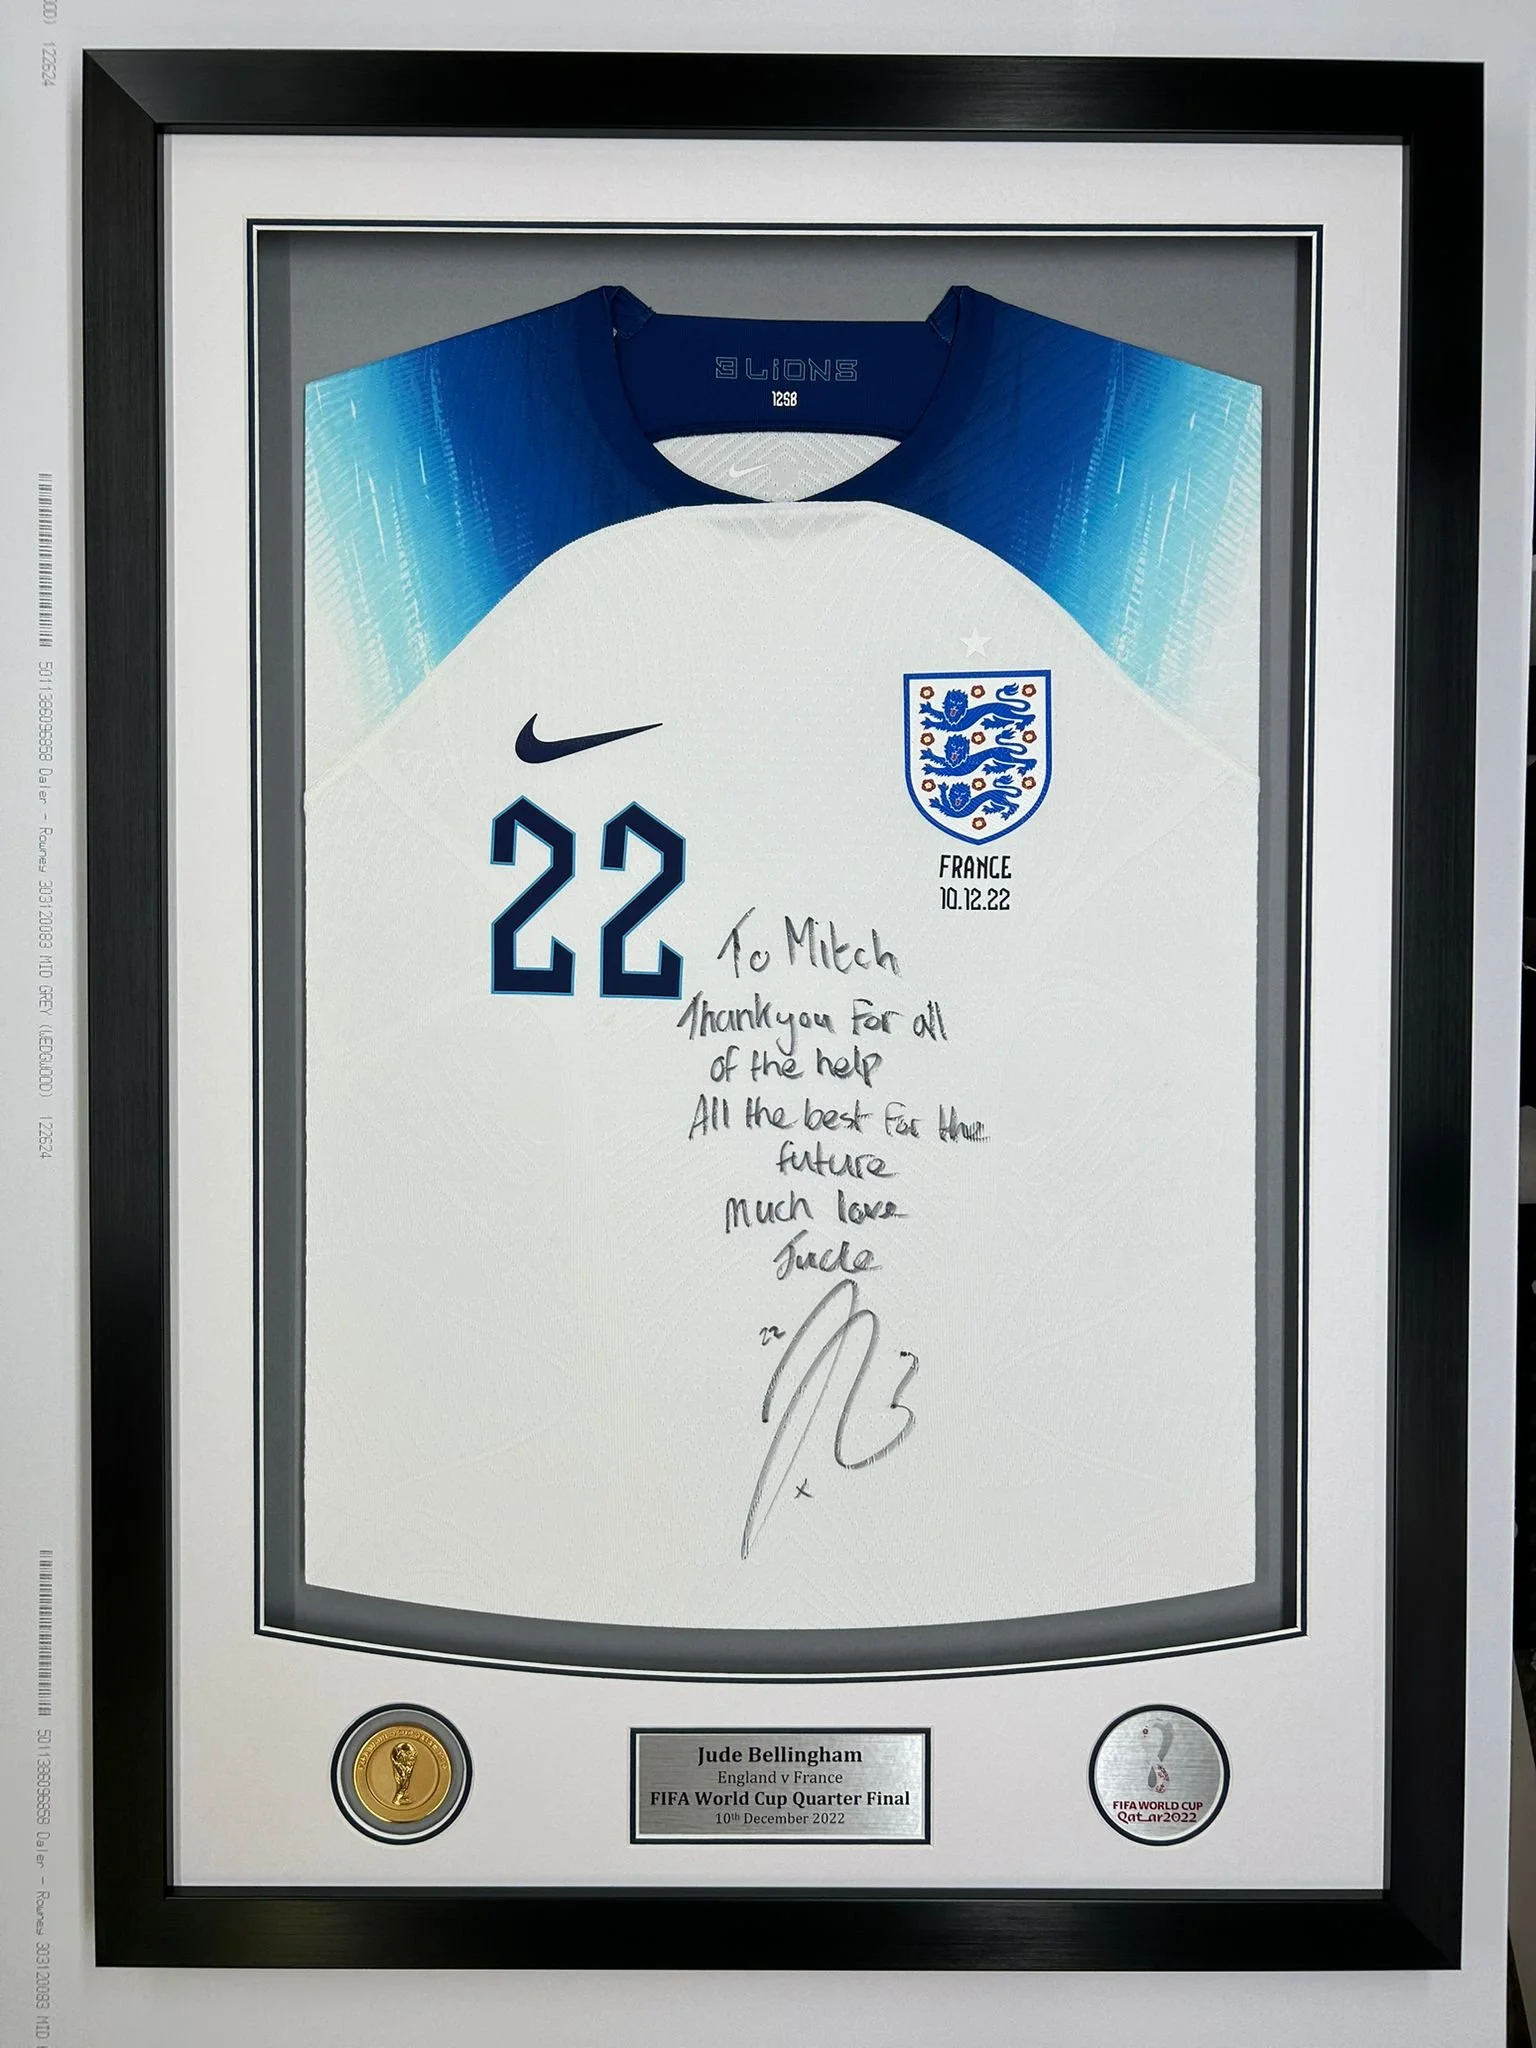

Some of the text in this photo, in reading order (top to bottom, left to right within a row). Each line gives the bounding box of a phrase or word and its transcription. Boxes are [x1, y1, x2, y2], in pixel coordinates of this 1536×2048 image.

[41, 40, 56, 88] 122624
[771, 390, 798, 407] 1258
[38, 767, 53, 805] Daler
[37, 826, 53, 873] Rowney
[938, 854, 1012, 880] FRANCE
[37, 879, 53, 949] 303120083
[489, 794, 687, 1001] 22
[939, 886, 1011, 911] 10.12.22
[716, 905, 902, 979] To Mitch
[38, 954, 53, 978] MID
[38, 984, 53, 1016] GREY
[912, 999, 948, 1042] all
[709, 1044, 884, 1088] of the help
[688, 1092, 730, 1141] All
[745, 1095, 798, 1130] the
[803, 1097, 873, 1134] best
[37, 1114, 53, 1160] 122624
[837, 1188, 910, 1226] love
[772, 1228, 884, 1281] Jude
[697, 1745, 863, 1767] Jude Bellingham
[717, 1771, 843, 1788] England v France
[649, 1790, 911, 1810] FIFA World Cup Quarter Final
[715, 1812, 845, 1825] 10th December 2022
[1112, 1800, 1204, 1811] FIFA WORLD CUP
[35, 1831, 50, 1869] Daler
[34, 1890, 50, 1936] Rowney
[34, 1941, 50, 2010] 303120083
[34, 2015, 50, 2040] MID
